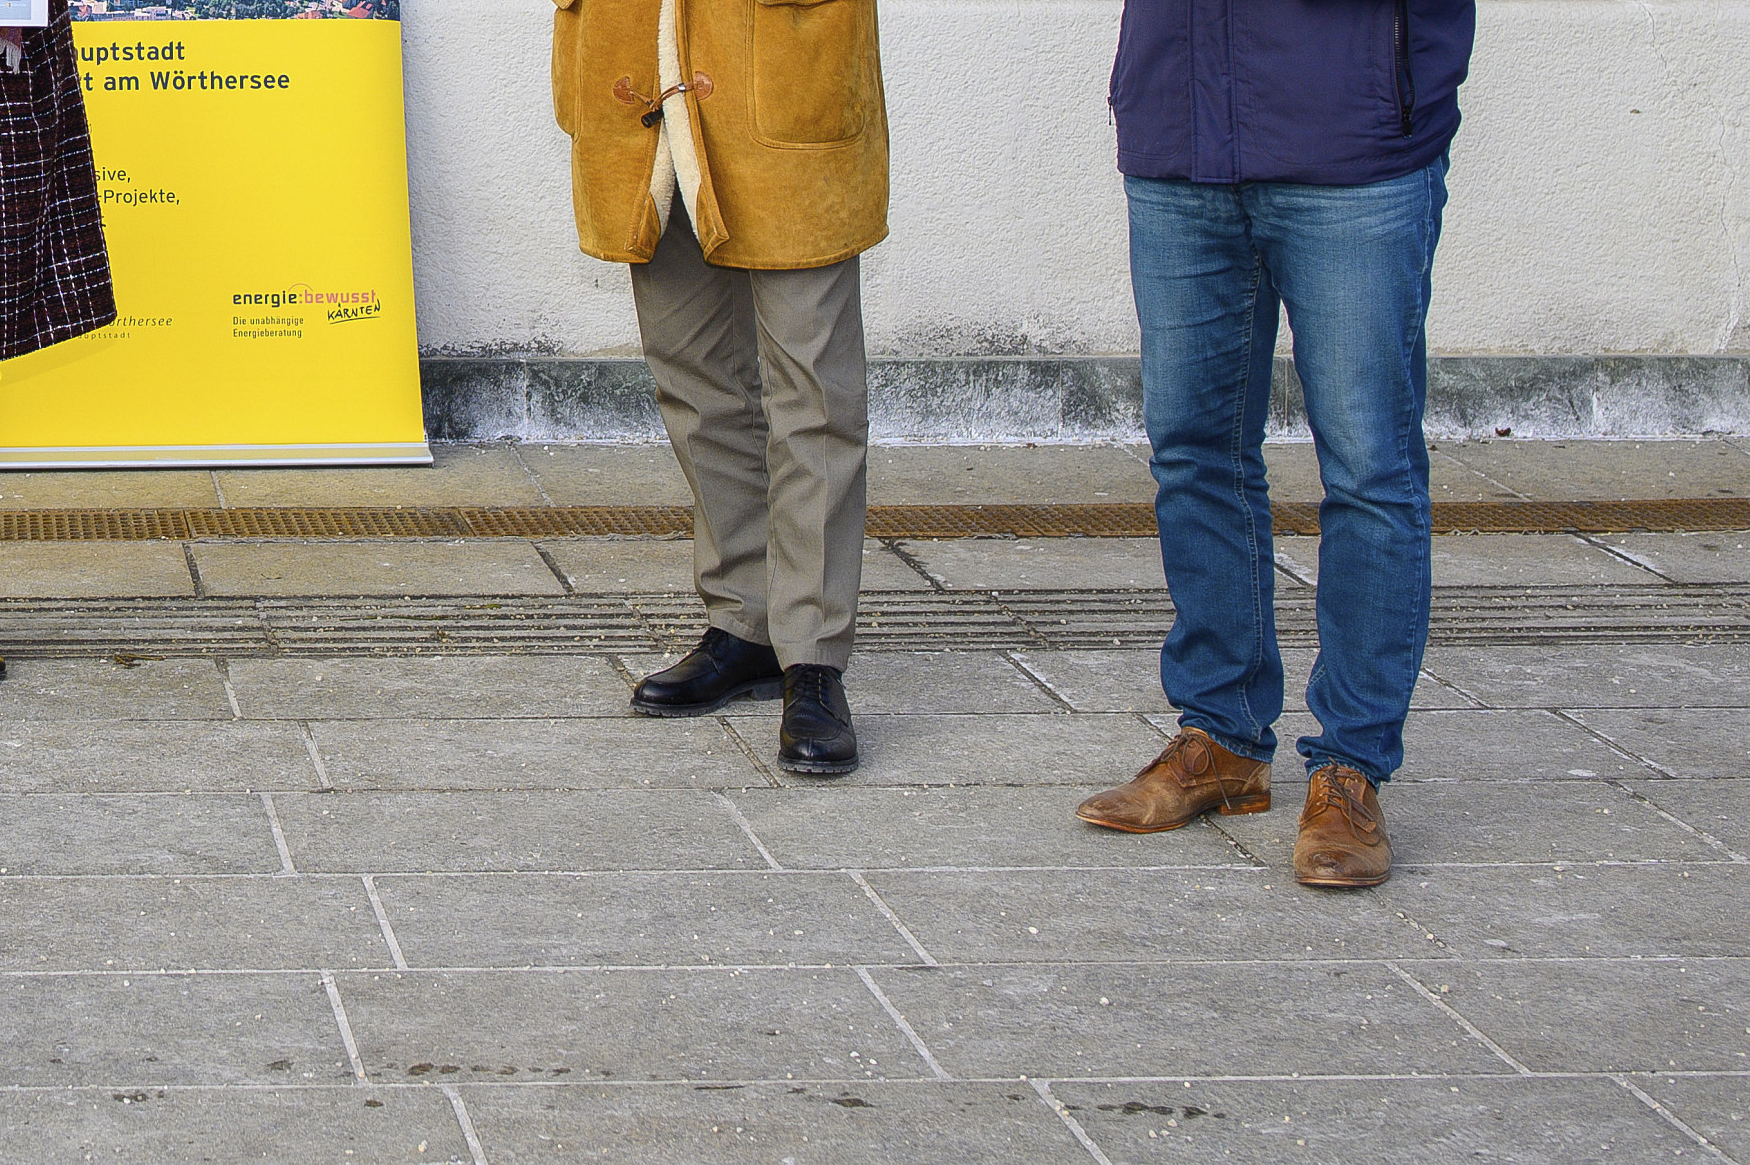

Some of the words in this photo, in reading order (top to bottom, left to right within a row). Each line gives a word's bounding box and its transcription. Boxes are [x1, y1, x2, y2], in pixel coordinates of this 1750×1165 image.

[103, 75, 139, 91] am
[150, 70, 290, 91] Wörthersee
[232, 316, 247, 325] Die
[250, 316, 304, 326] unabhängige
[232, 328, 302, 339] Energieberatung
